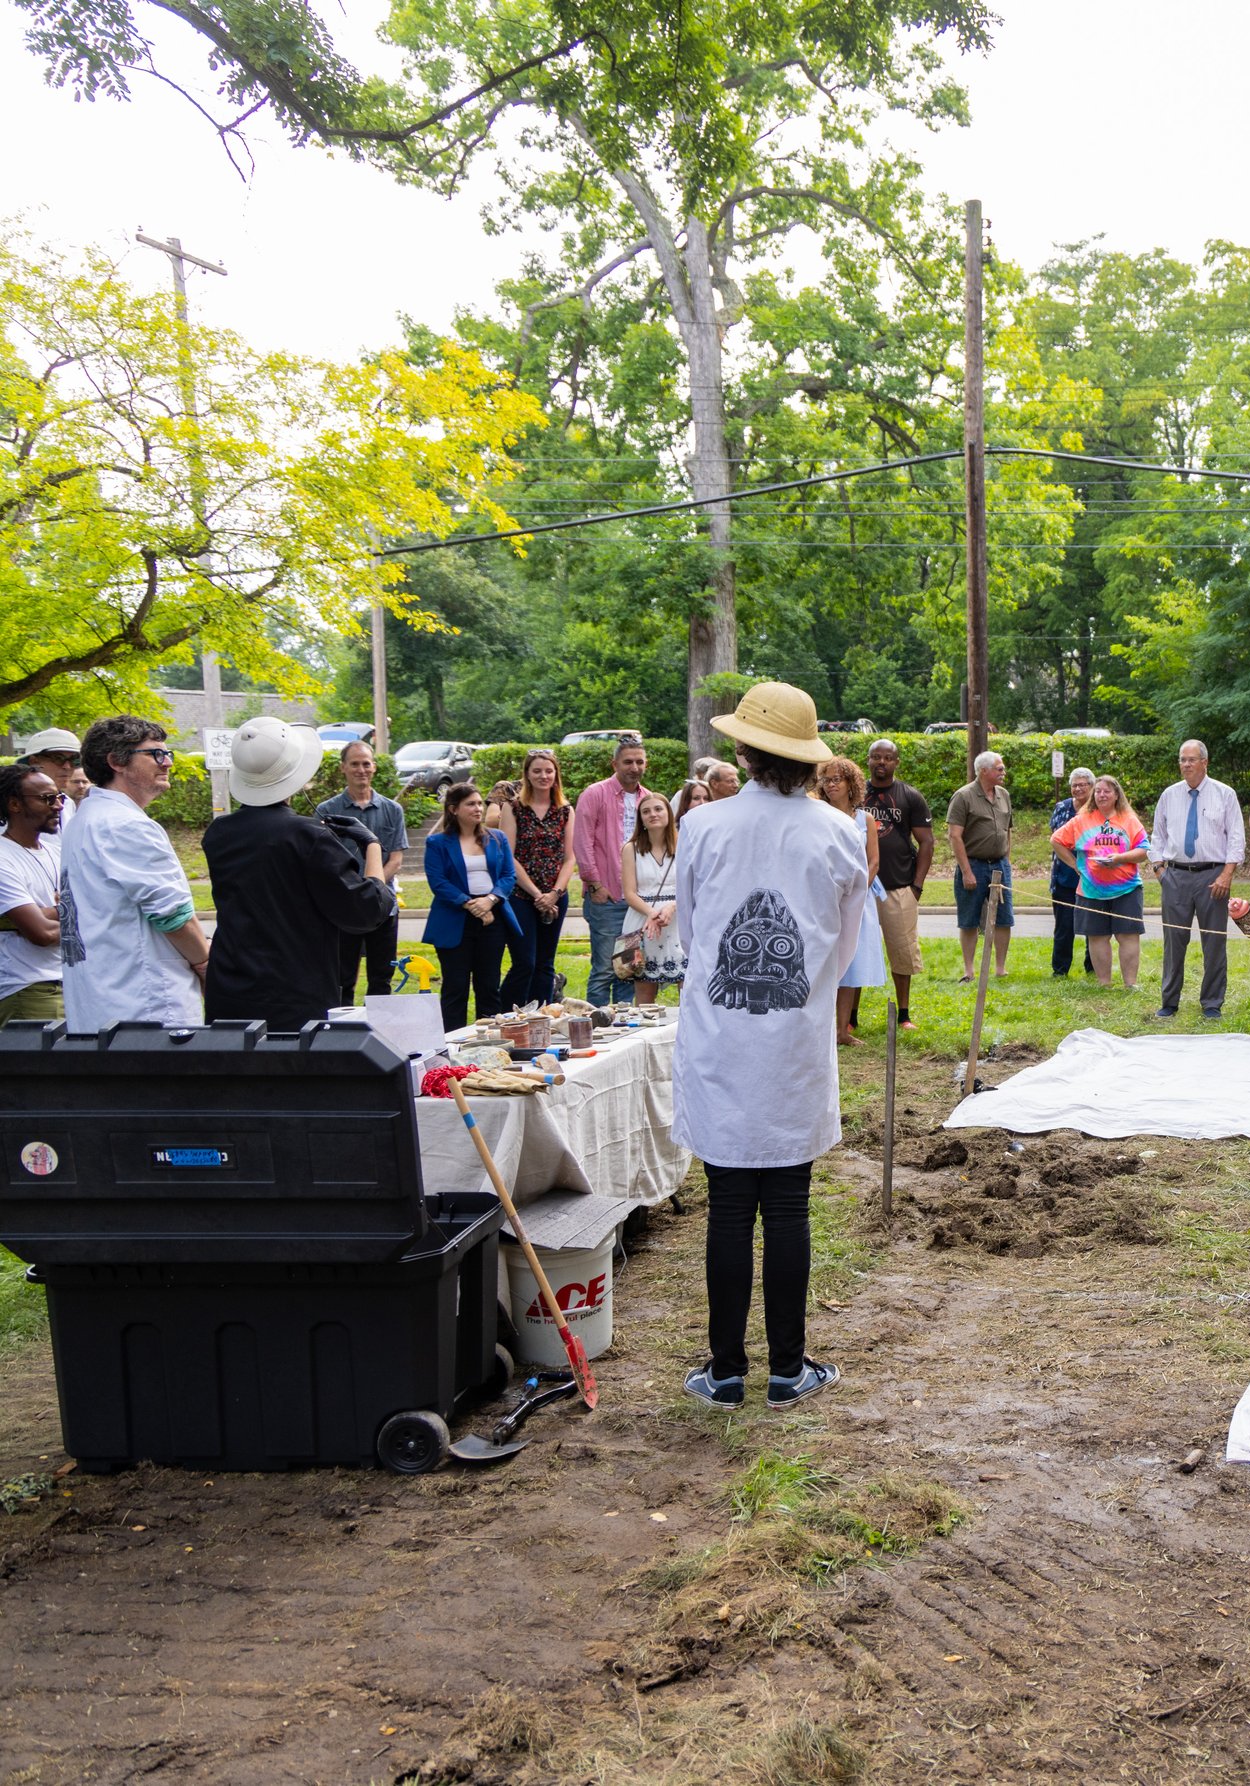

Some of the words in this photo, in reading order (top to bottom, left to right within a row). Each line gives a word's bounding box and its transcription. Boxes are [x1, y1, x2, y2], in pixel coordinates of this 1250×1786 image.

[1095, 836, 1120, 846] kind
[525, 1273, 606, 1318] ACE
[527, 1317, 541, 1325] The
[544, 1312, 578, 1325] heful
